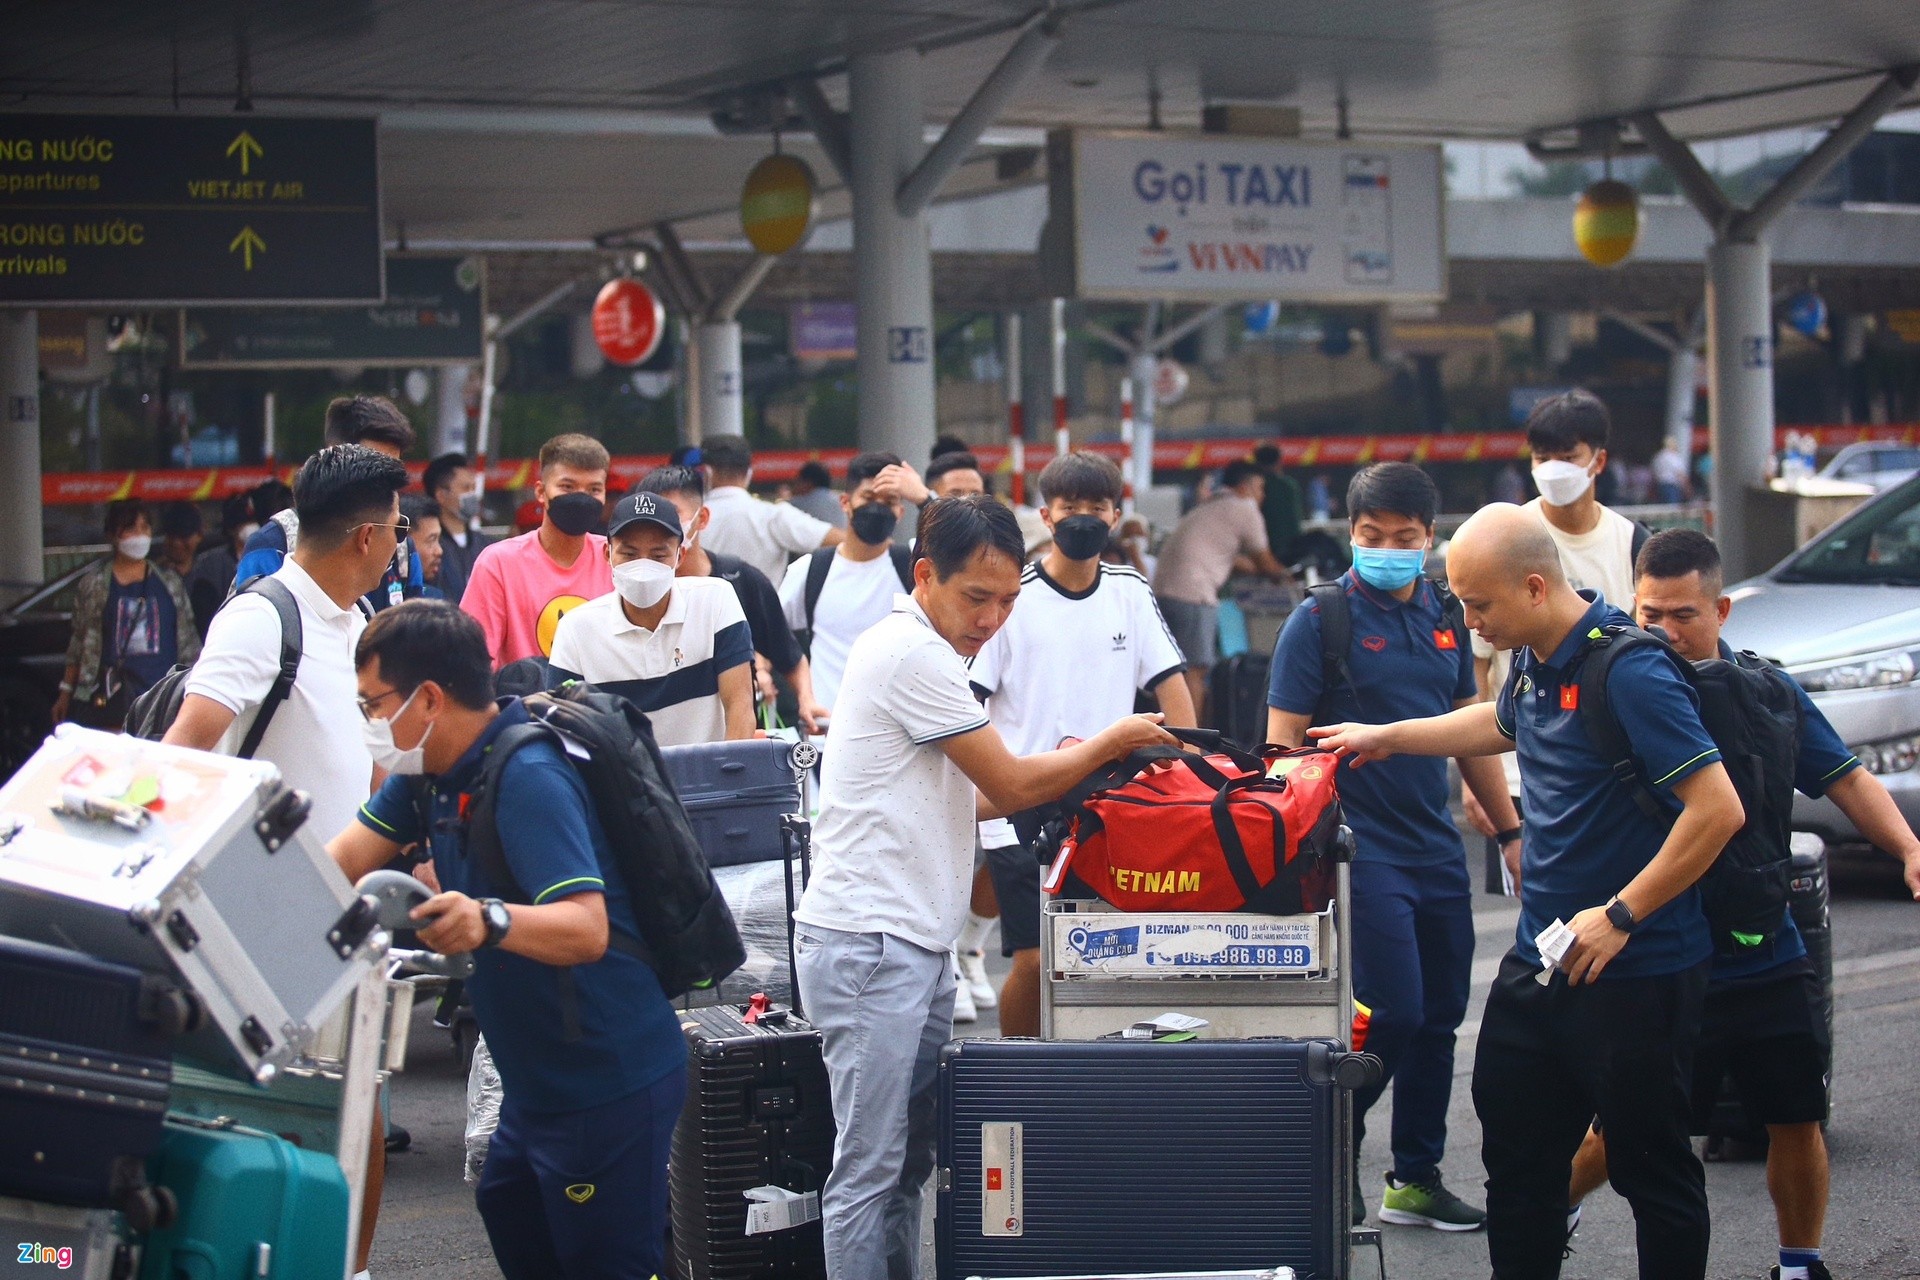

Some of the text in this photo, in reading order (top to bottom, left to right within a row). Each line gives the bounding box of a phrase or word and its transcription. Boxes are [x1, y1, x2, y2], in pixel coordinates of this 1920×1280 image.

[43, 135, 114, 162] NƯỚC
[188, 180, 304, 199] VIETJET AIR
[1135, 161, 1310, 216] Gọi TAXI
[73, 219, 145, 245] NƯỚC
[635, 494, 656, 515] LA
[1145, 924, 1190, 935] BIZMAN
